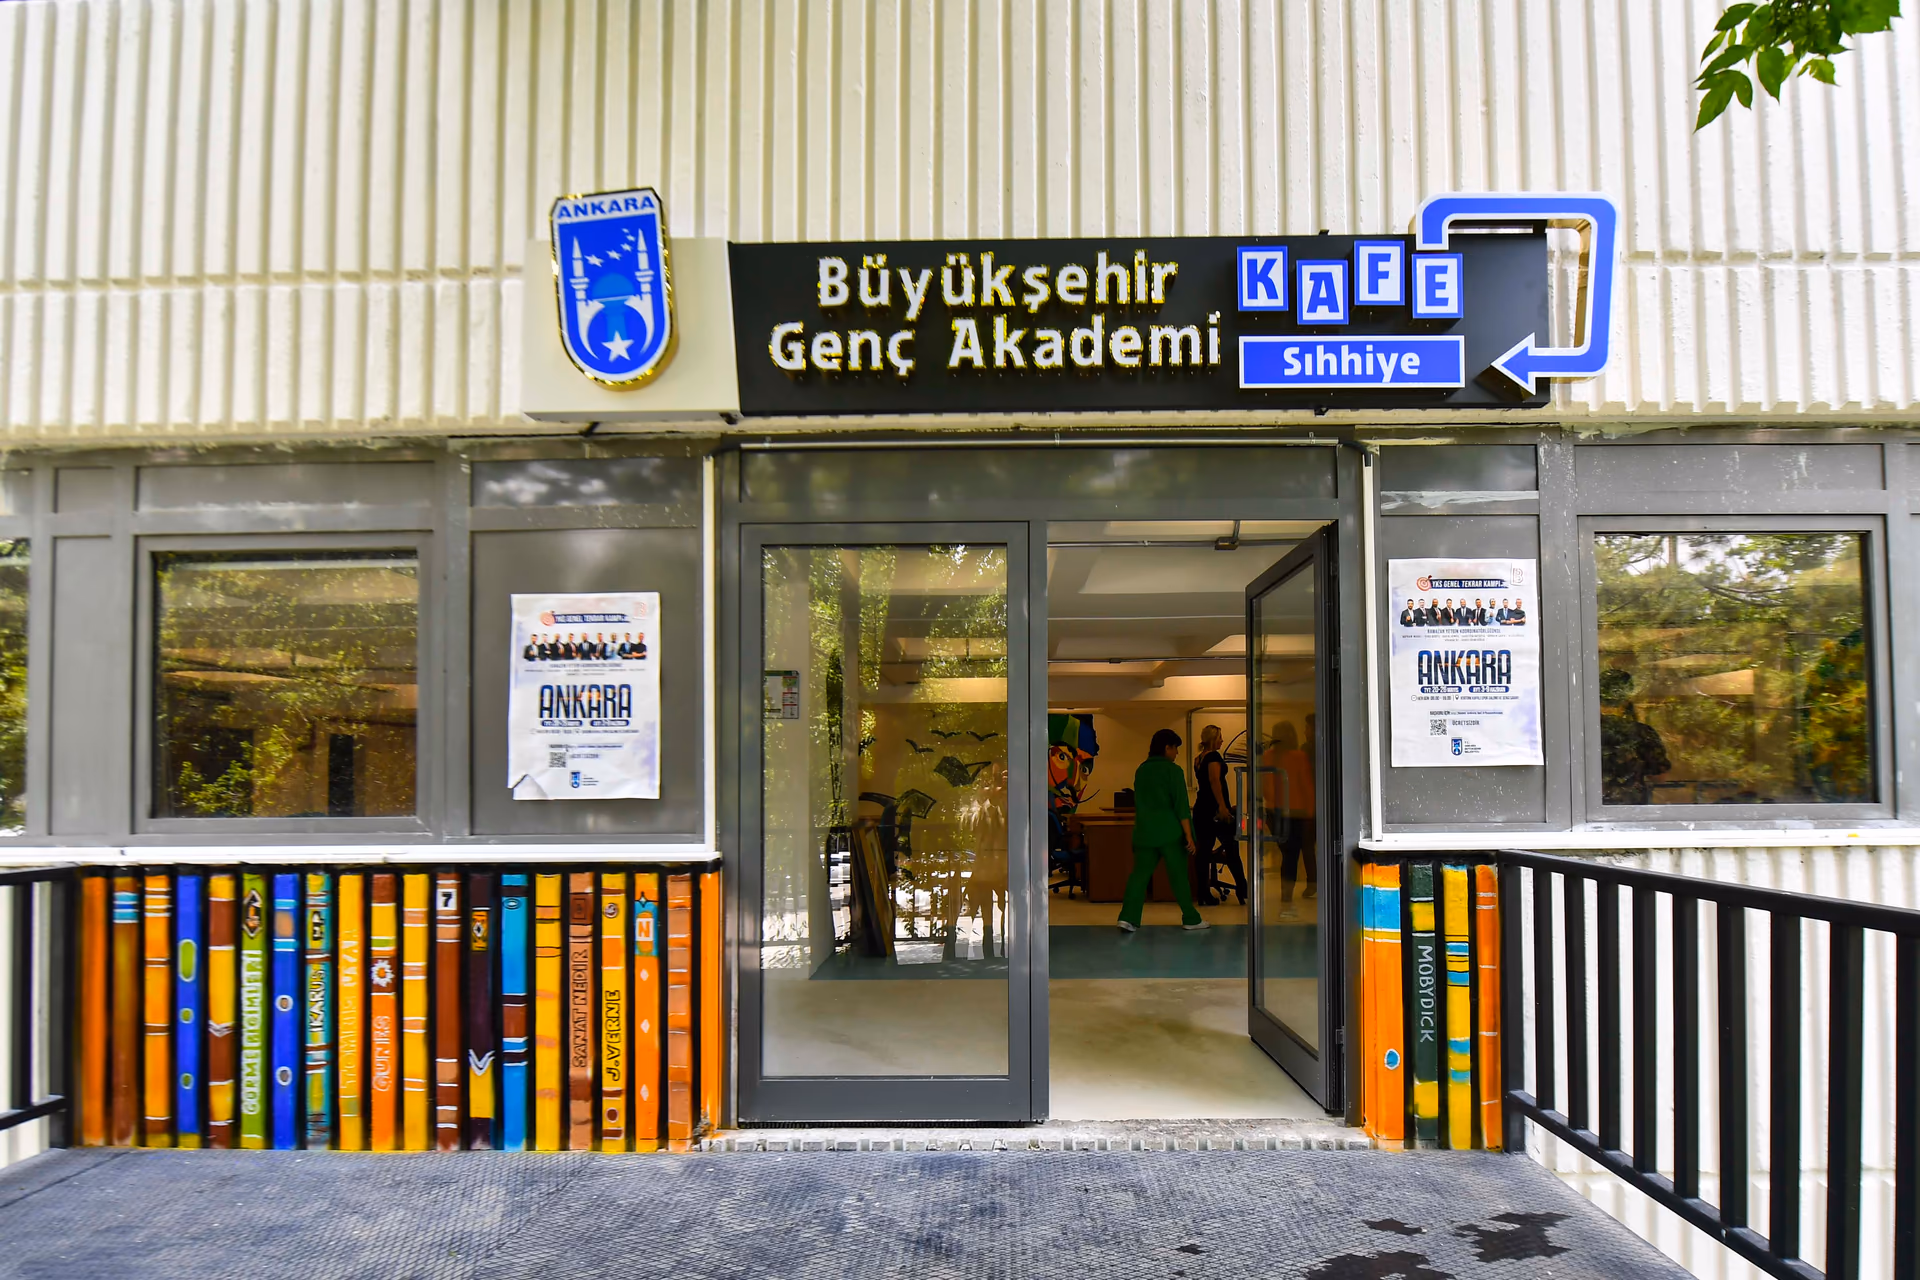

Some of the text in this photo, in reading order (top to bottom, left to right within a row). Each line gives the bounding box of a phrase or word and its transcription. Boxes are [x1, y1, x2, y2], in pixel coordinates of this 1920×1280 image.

[557, 195, 655, 219] ANKARA
[817, 250, 1178, 321] Büyükşehir
[1246, 252, 1450, 314] KAFE
[768, 310, 1222, 377] Genç Akademi
[1283, 344, 1421, 383] Sıhhiye
[1443, 580, 1460, 588] GENEL
[1462, 580, 1482, 588] TEKRAR
[1418, 650, 1511, 685] ANKARA
[539, 684, 632, 718] ANKARA
[441, 892, 453, 908] 7
[638, 920, 651, 937] N
[1417, 945, 1435, 1042] MOBYDICK
[572, 1008, 590, 1068] SANAT
